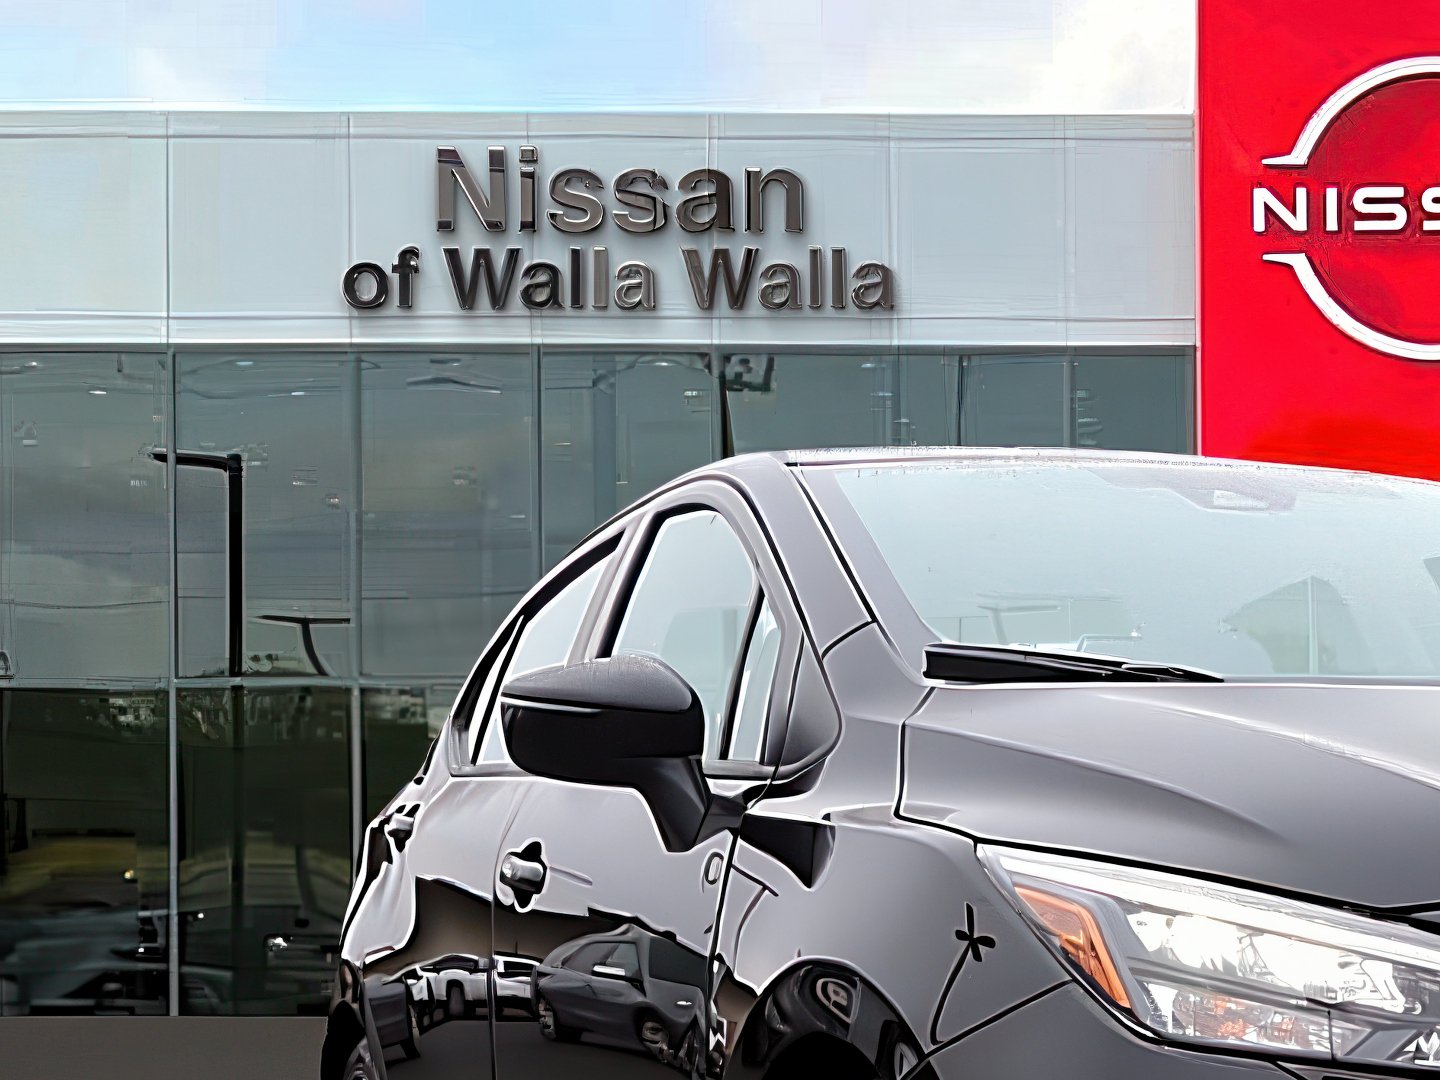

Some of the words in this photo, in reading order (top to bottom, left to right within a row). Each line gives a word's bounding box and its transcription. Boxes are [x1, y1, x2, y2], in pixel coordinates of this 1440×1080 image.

[435, 144, 806, 233] Nissan
[341, 245, 422, 310] of
[442, 245, 656, 311] Walla
[680, 245, 895, 311] Walla
